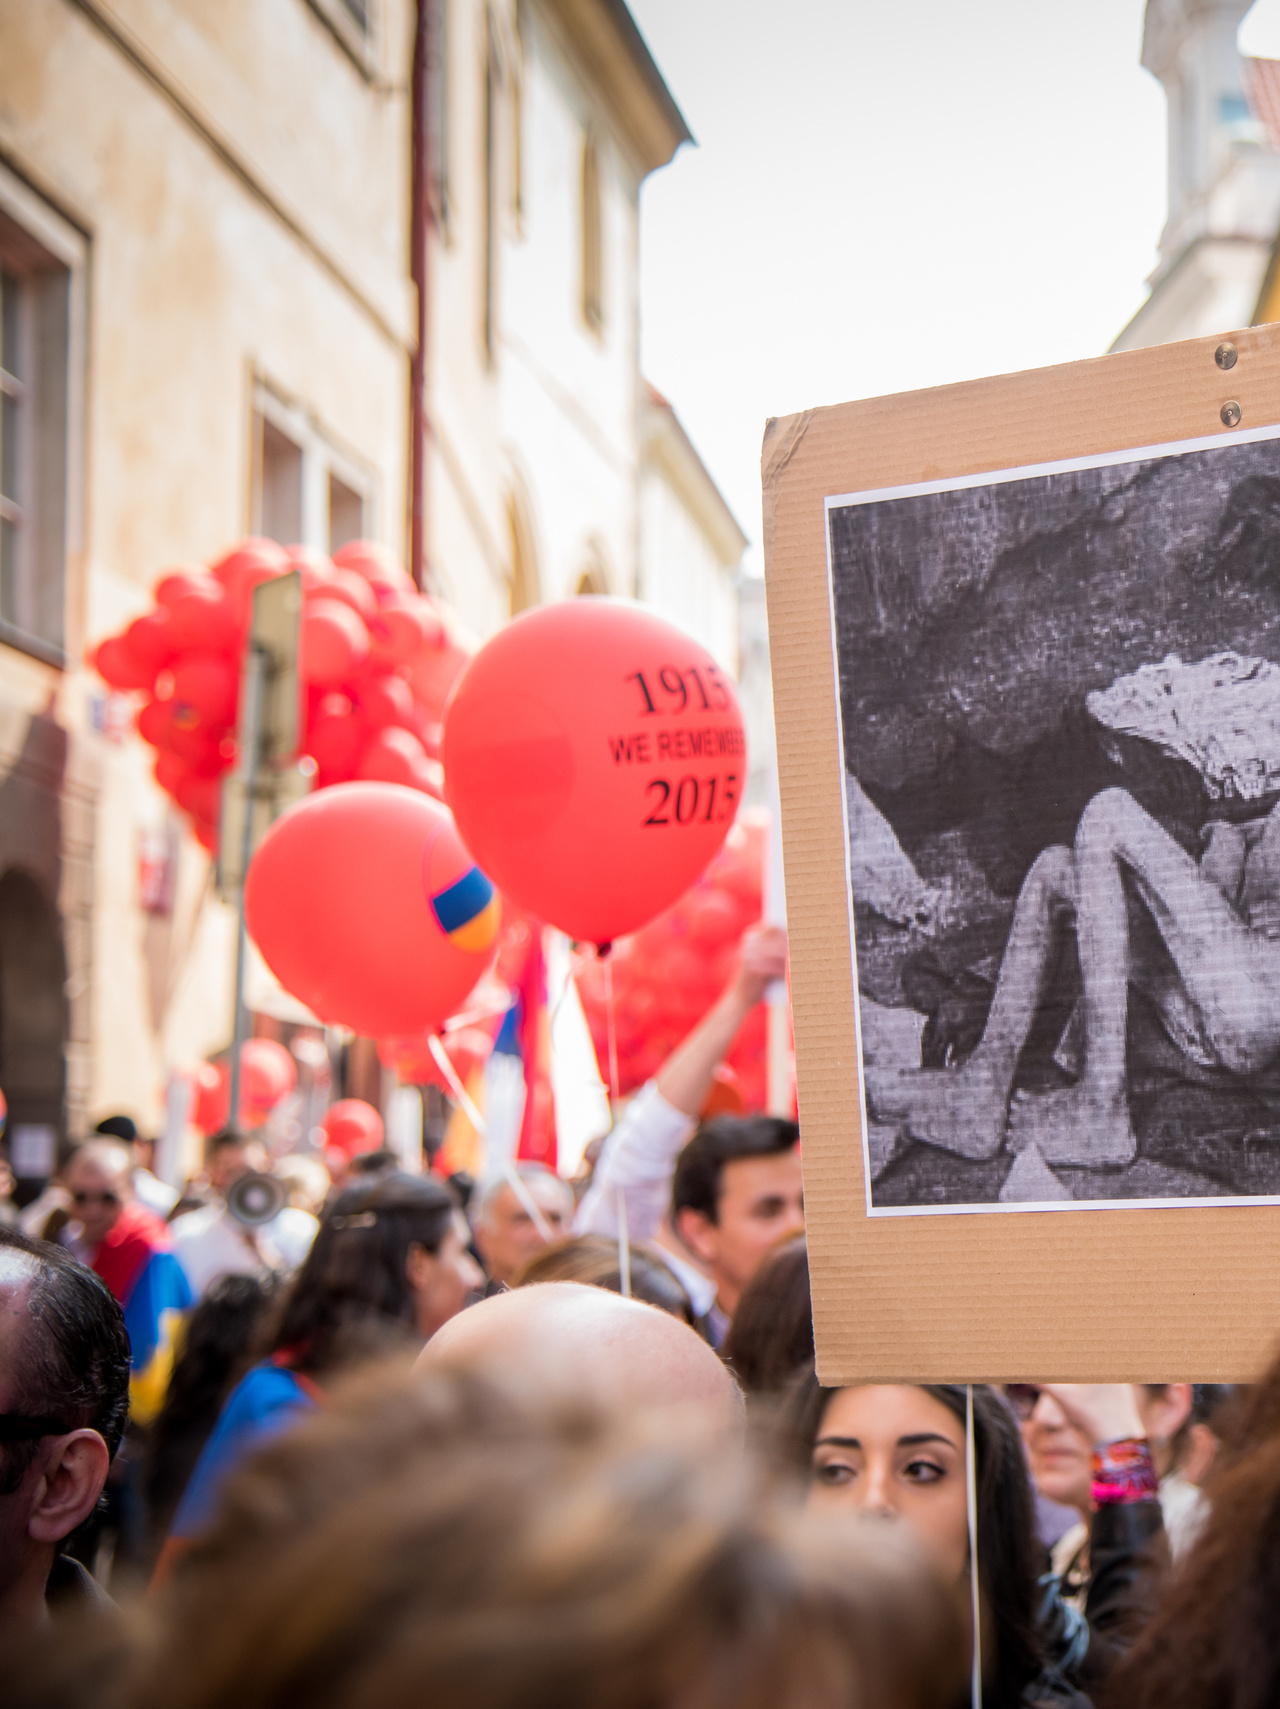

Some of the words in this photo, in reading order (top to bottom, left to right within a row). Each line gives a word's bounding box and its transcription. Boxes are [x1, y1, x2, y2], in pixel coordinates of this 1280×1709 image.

[626, 664, 732, 716] 1915
[608, 732, 651, 765] WE
[641, 768, 737, 826] 2015
